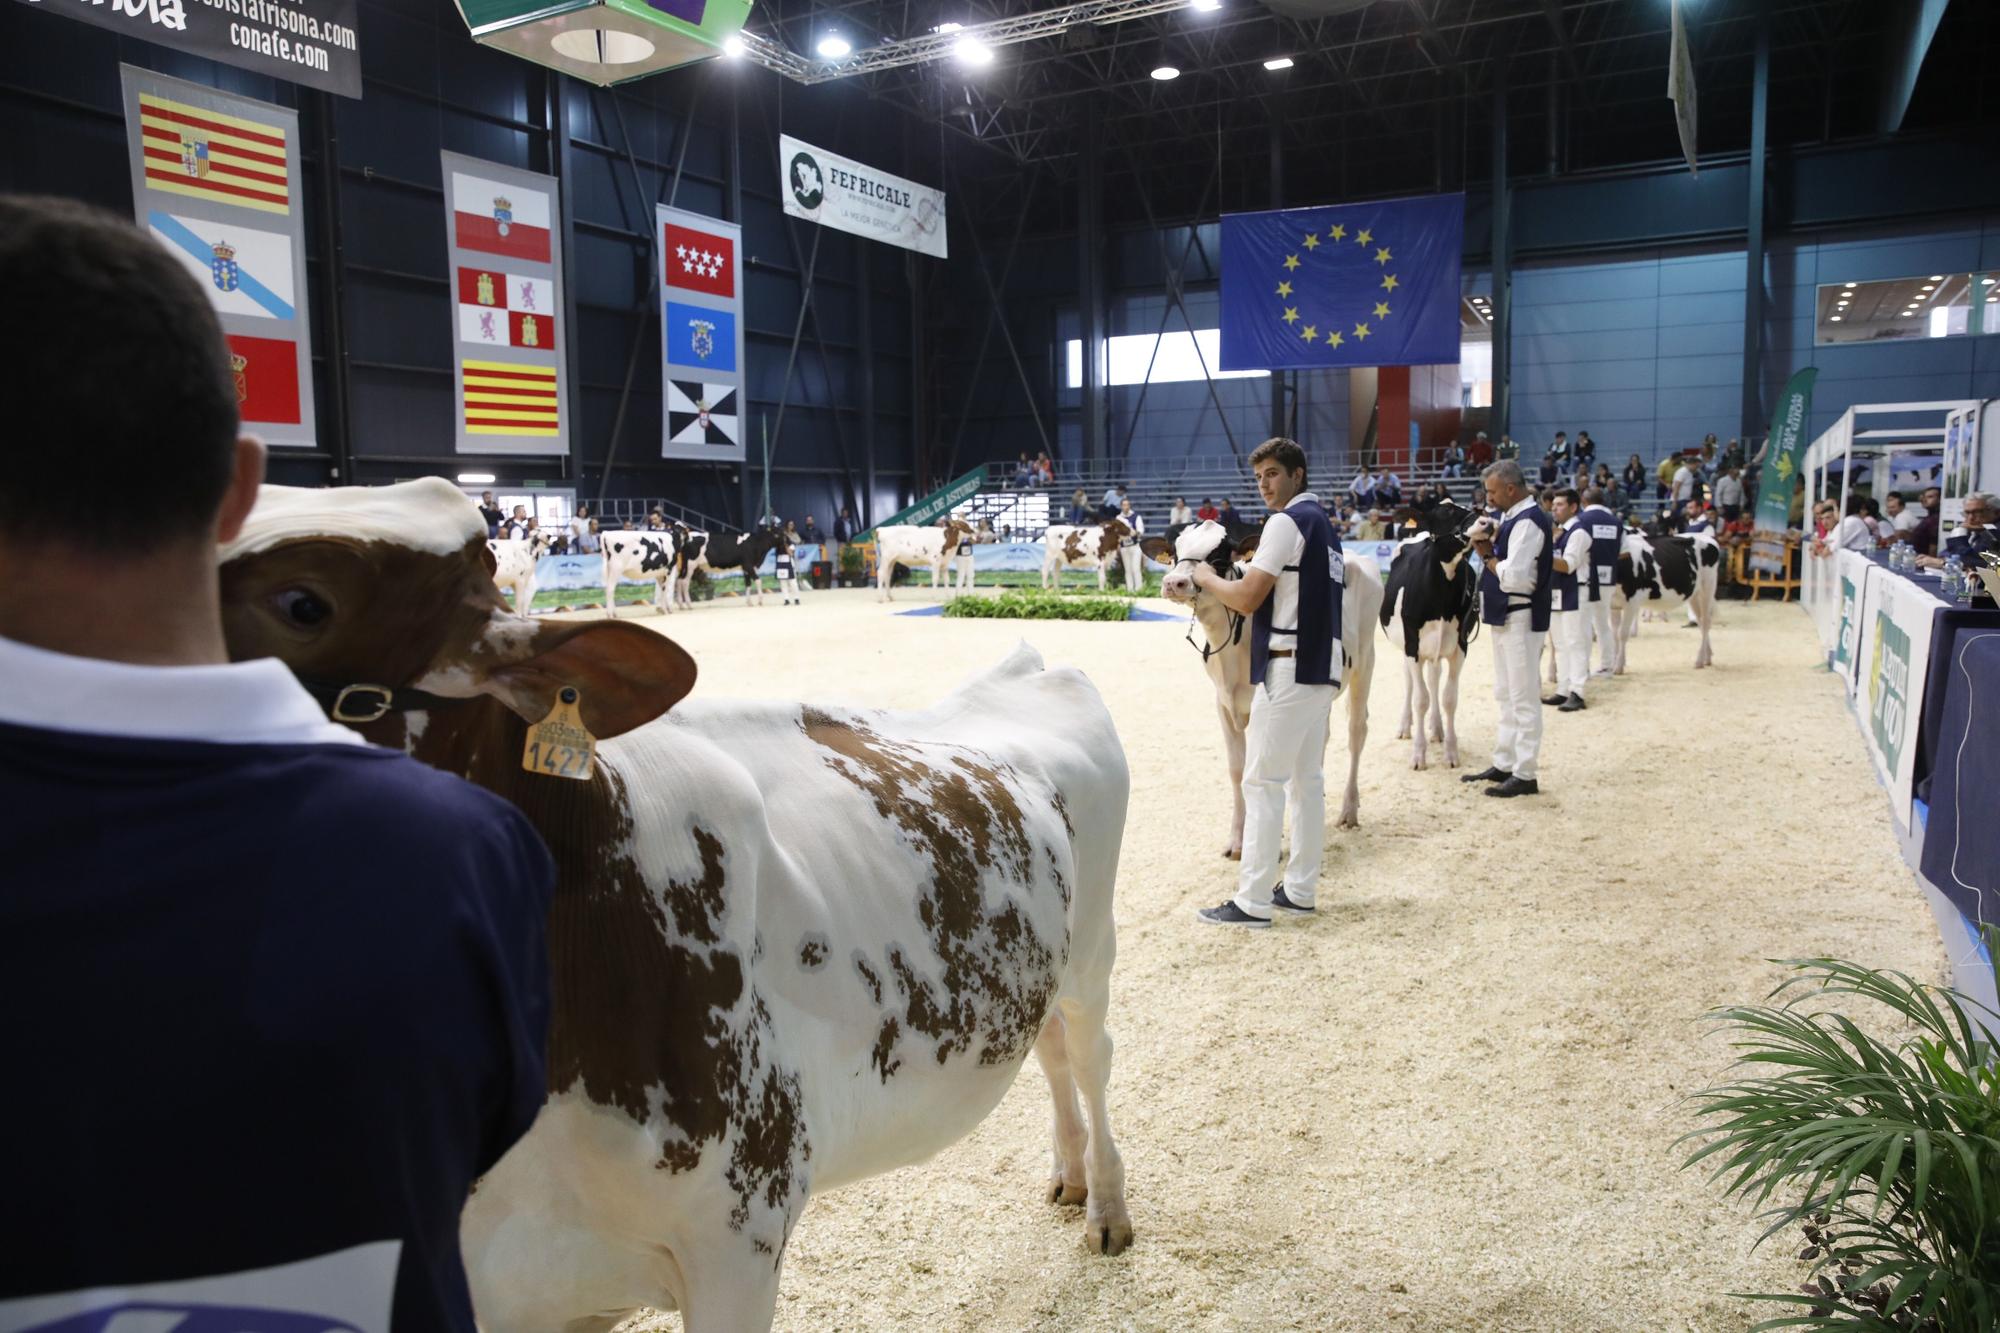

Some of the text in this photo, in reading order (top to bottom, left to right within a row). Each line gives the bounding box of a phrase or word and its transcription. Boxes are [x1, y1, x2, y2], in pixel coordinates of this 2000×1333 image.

[230, 22, 329, 72] conafe.com
[830, 168, 911, 209] FEFRICALE
[932, 497, 945, 513] DE
[530, 742, 589, 776] 1427
